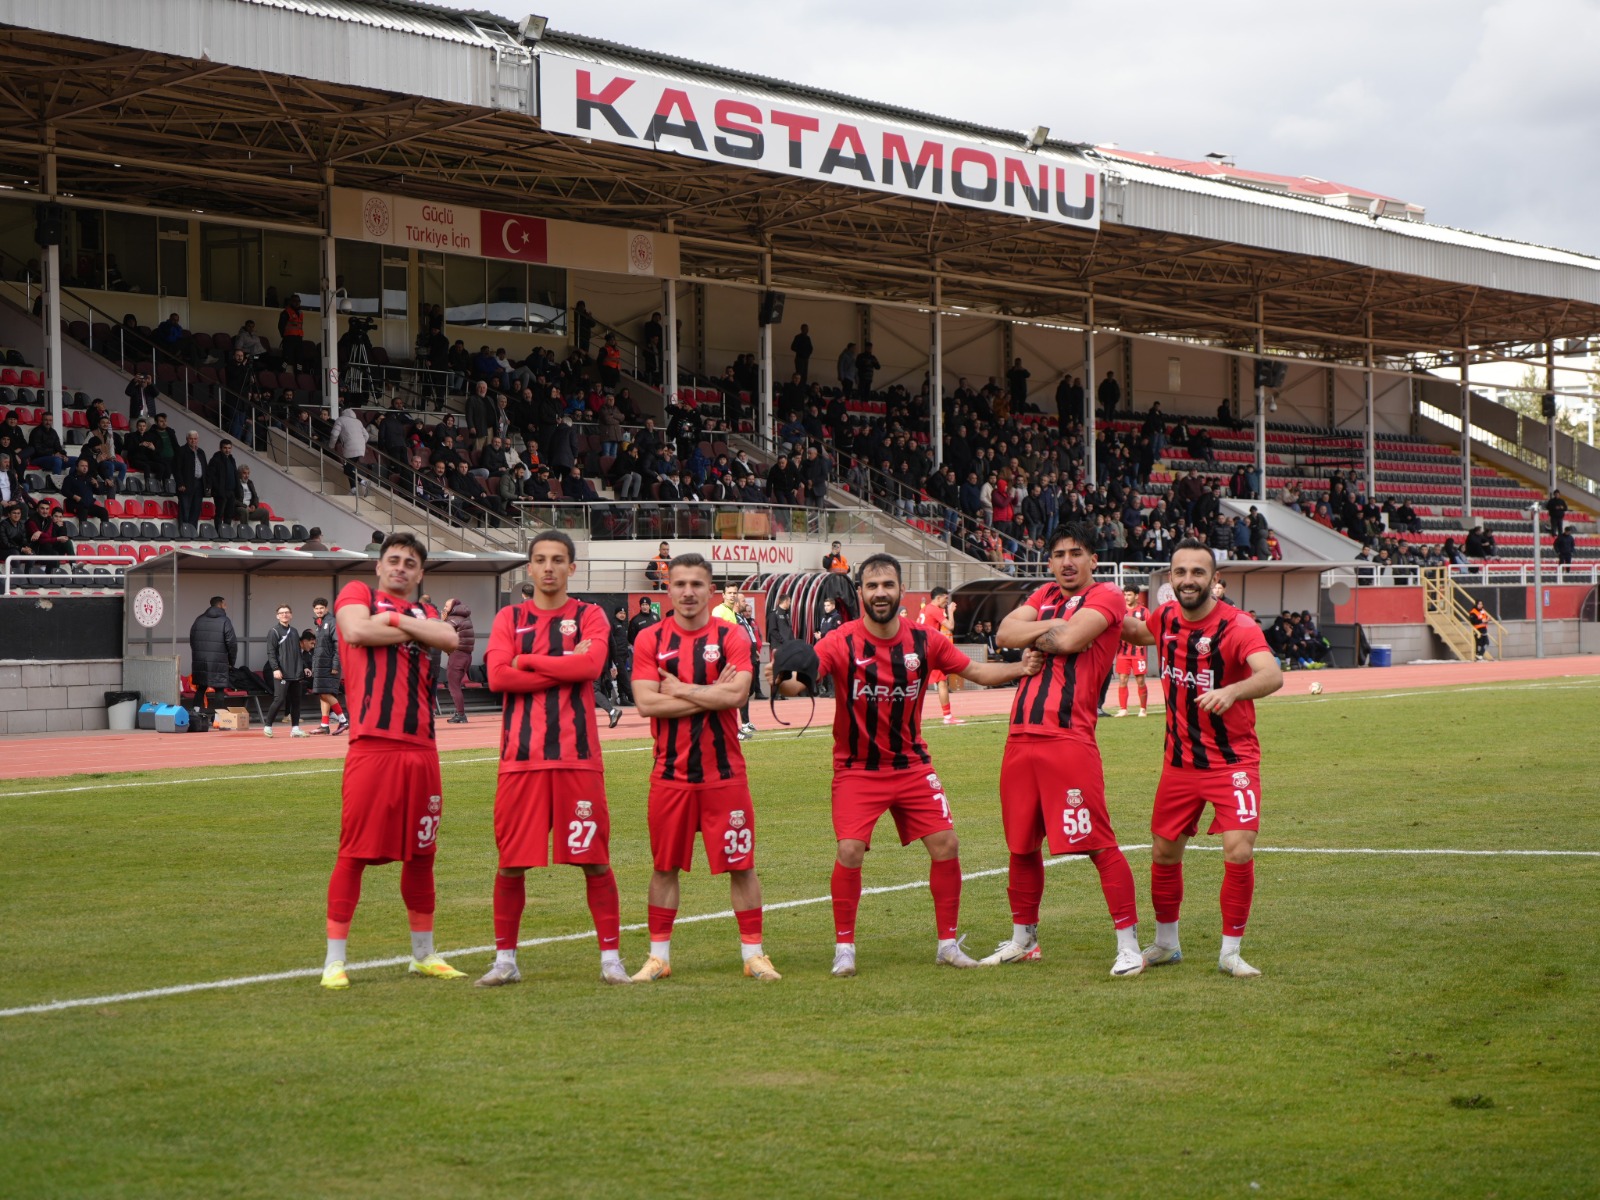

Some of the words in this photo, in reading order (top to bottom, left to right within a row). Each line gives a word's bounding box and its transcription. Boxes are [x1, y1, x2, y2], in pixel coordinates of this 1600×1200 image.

[575, 69, 1095, 221] KASTAMONU
[422, 205, 454, 225] Güçlü
[406, 225, 448, 249] Türkiye
[451, 228, 471, 249] İçin
[712, 545, 793, 563] KASTAMONU
[1233, 789, 1258, 817] 11
[417, 815, 441, 841] 37
[567, 820, 598, 848] 27
[1063, 808, 1092, 835] 58
[724, 828, 752, 855] 33
